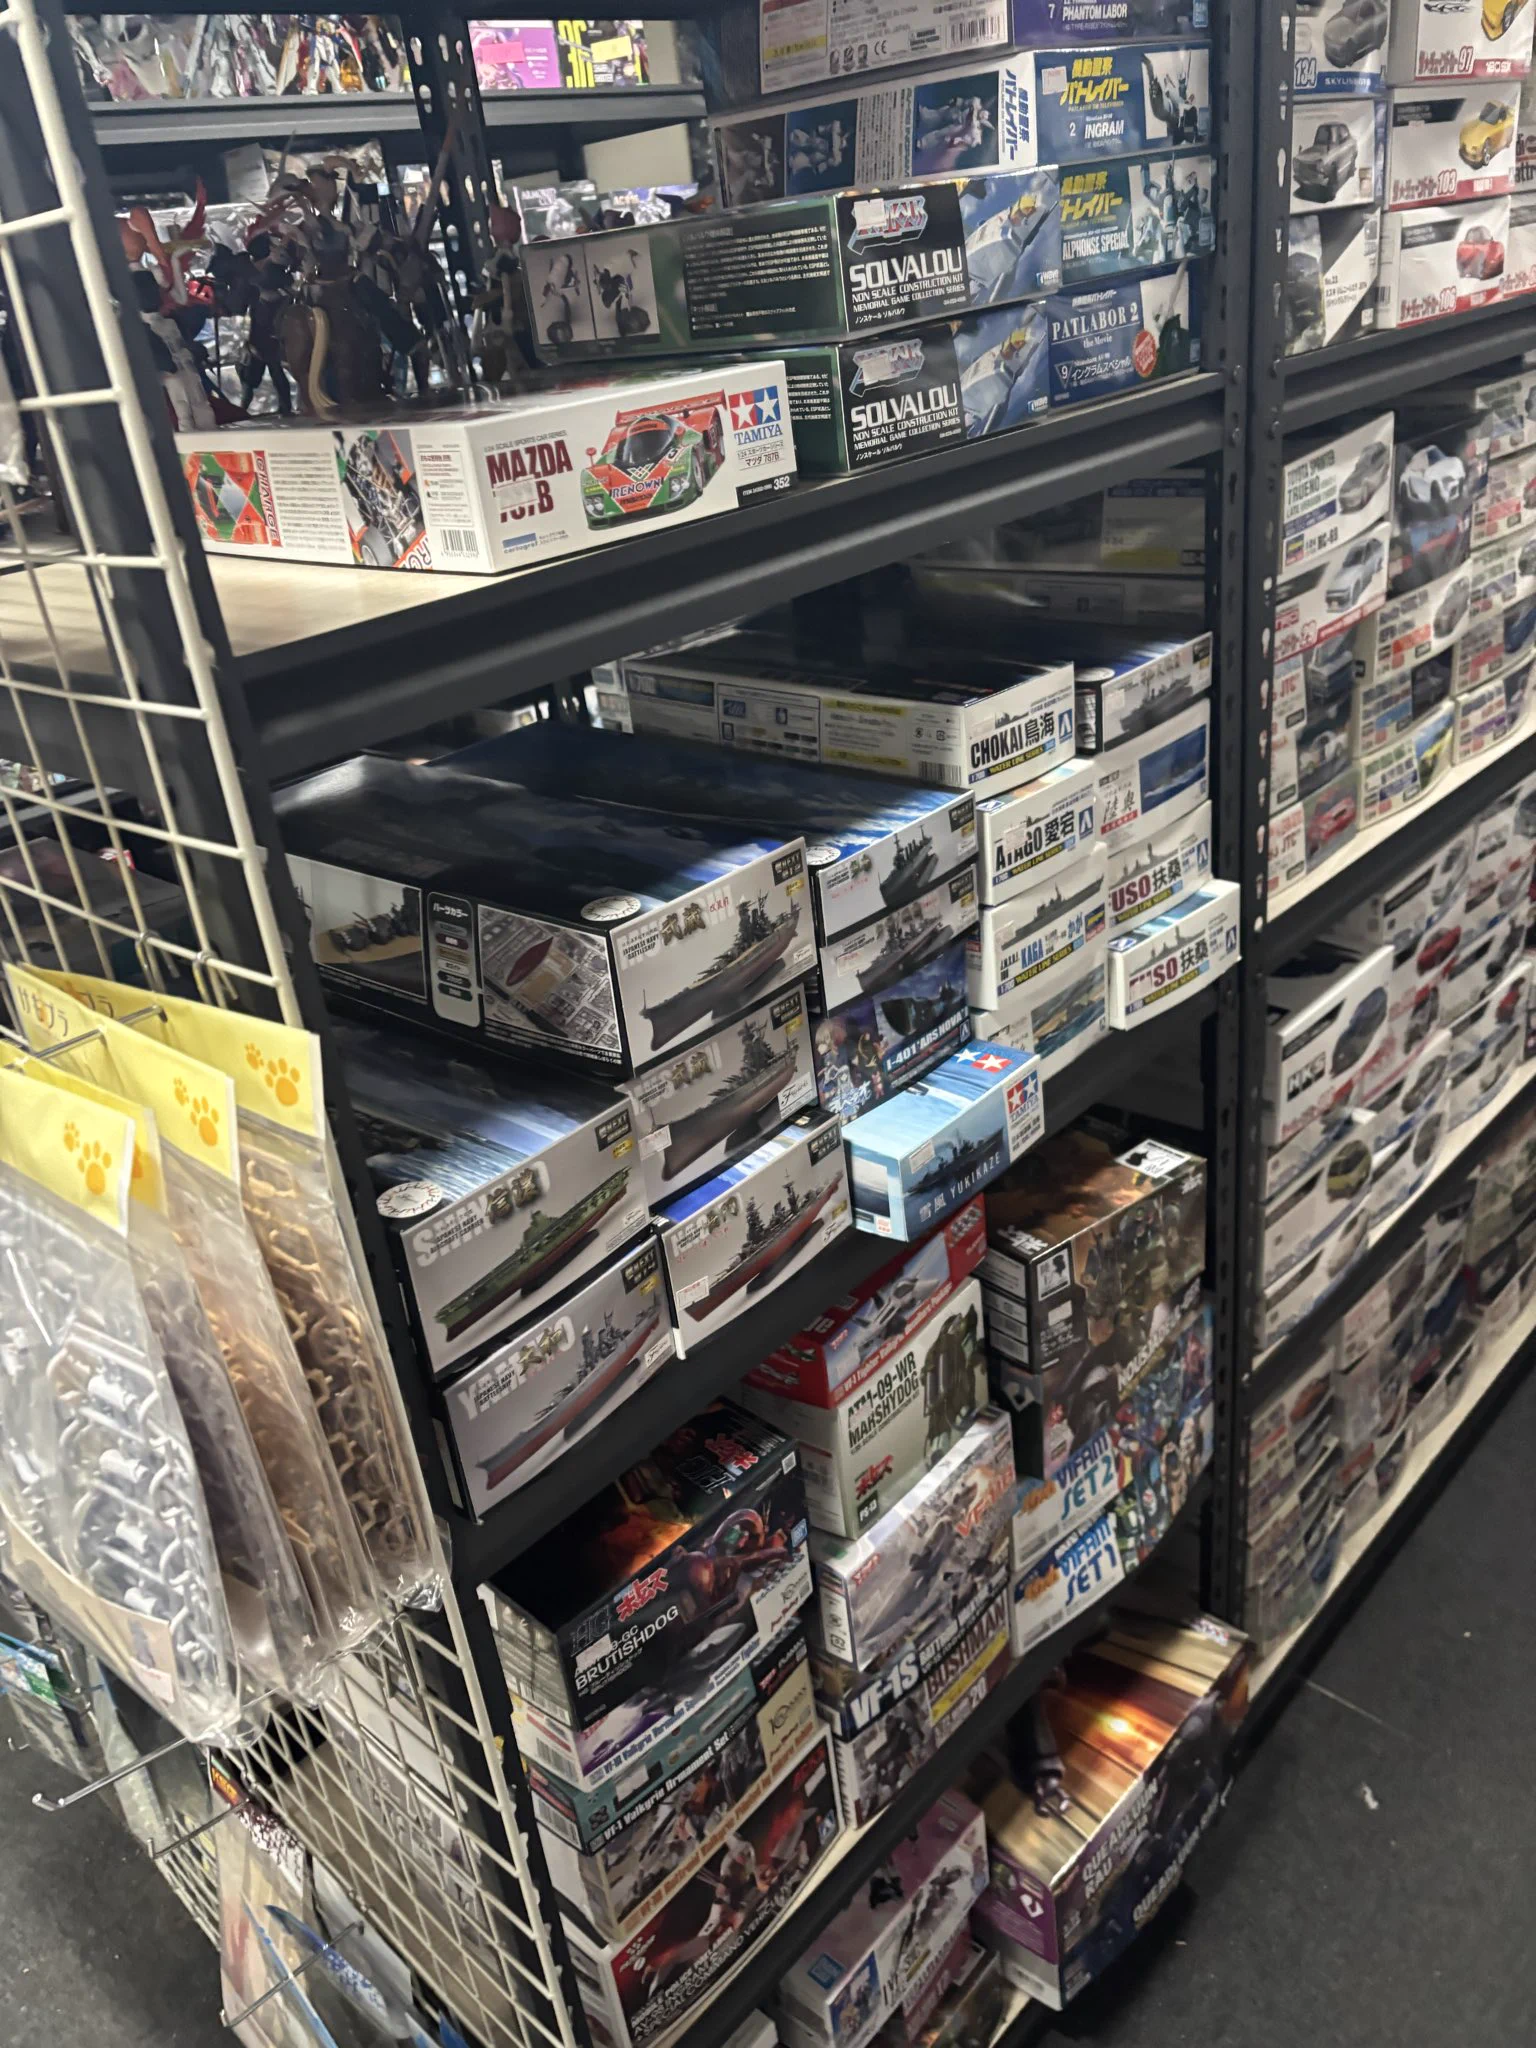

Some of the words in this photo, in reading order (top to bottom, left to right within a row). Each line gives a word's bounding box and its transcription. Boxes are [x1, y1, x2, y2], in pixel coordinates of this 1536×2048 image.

[1048, 4, 1056, 19] 7
[1062, 6, 1101, 21] PHANTOM
[1102, 3, 1128, 18] LABOR
[1295, 57, 1317, 88] 134
[1458, 46, 1474, 73] 97
[1069, 122, 1077, 137] 2
[1084, 119, 1125, 140] INGRAM
[1437, 169, 1457, 196] 103
[1063, 235, 1100, 261] ALPHONSE
[1101, 230, 1130, 250] SPECIAL
[850, 246, 963, 292] SOLVALOU
[852, 290, 871, 303] NON
[871, 285, 897, 299] SCALE
[899, 275, 952, 294] CONSTRUCTION
[952, 272, 964, 285] KIT
[853, 299, 890, 313] MEMORIAL
[891, 294, 911, 306] GAME
[912, 288, 946, 301] COLLECTION
[946, 283, 966, 295] SERIES
[1052, 306, 1127, 341] PATLABOR
[1130, 302, 1139, 322] 2
[1094, 334, 1113, 346] Movie
[1061, 364, 1068, 380] 9
[850, 383, 958, 432] SOLVALOU
[536, 433, 548, 442] CAR
[734, 423, 783, 446] TAMIYA
[852, 429, 871, 442] NON
[871, 424, 895, 438] SCALE
[897, 413, 948, 431] CONSTRUCTION
[948, 408, 960, 419] KIT
[854, 436, 889, 451] MEMORIAL
[889, 431, 908, 443] GAME
[908, 422, 942, 438] COLLECTION
[942, 417, 962, 429] SERIES
[486, 439, 574, 489] MAZDA
[745, 455, 762, 467] マツダ
[763, 451, 780, 464] 787B
[612, 479, 662, 499] RENOWN
[773, 475, 791, 491] 352
[970, 724, 1023, 769] CHOKAI
[1025, 711, 1054, 747] 鳥海
[1108, 873, 1151, 913] USO
[1152, 856, 1182, 893] 扶桑
[622, 939, 646, 956] JAPANESE
[645, 933, 660, 947] NAVY
[627, 942, 657, 960] BATTLESHIP
[1021, 938, 1044, 970] KAGA
[1067, 911, 1083, 940] かが
[1015, 967, 1038, 984] WATER
[1037, 957, 1051, 973] LINE
[1129, 956, 1179, 988] SO
[1181, 938, 1208, 974] 扶桑
[886, 1052, 916, 1072] I-401
[1286, 1051, 1327, 1102] HKS
[1010, 1094, 1040, 1124] TAMIYA
[949, 1151, 1001, 1200] YUKIKAZE
[458, 1217, 484, 1239] CARRIER
[462, 1213, 479, 1230] NAVY
[501, 1370, 516, 1385] NAVY
[479, 1380, 513, 1407] BATTLESHIP
[1057, 1433, 1110, 1490] VIFAM
[1061, 1463, 1099, 1521] SET
[1100, 1454, 1115, 1487] 2
[1059, 1515, 1112, 1577] VIFAM
[1065, 1551, 1103, 1607] SET
[1104, 1542, 1118, 1569] 1
[575, 1605, 680, 1692] BRUTISHDOG
[926, 1594, 1008, 1700] BUSHMAN
[850, 1651, 920, 1730] VF-1S
[603, 1816, 624, 1842] VF-1
[623, 1788, 666, 1827] Valkyrie
[665, 1747, 715, 1793] Armament
[714, 1729, 731, 1754] Set
[1085, 1857, 1114, 1899] RAU
[686, 1934, 744, 1995] COMMAND
